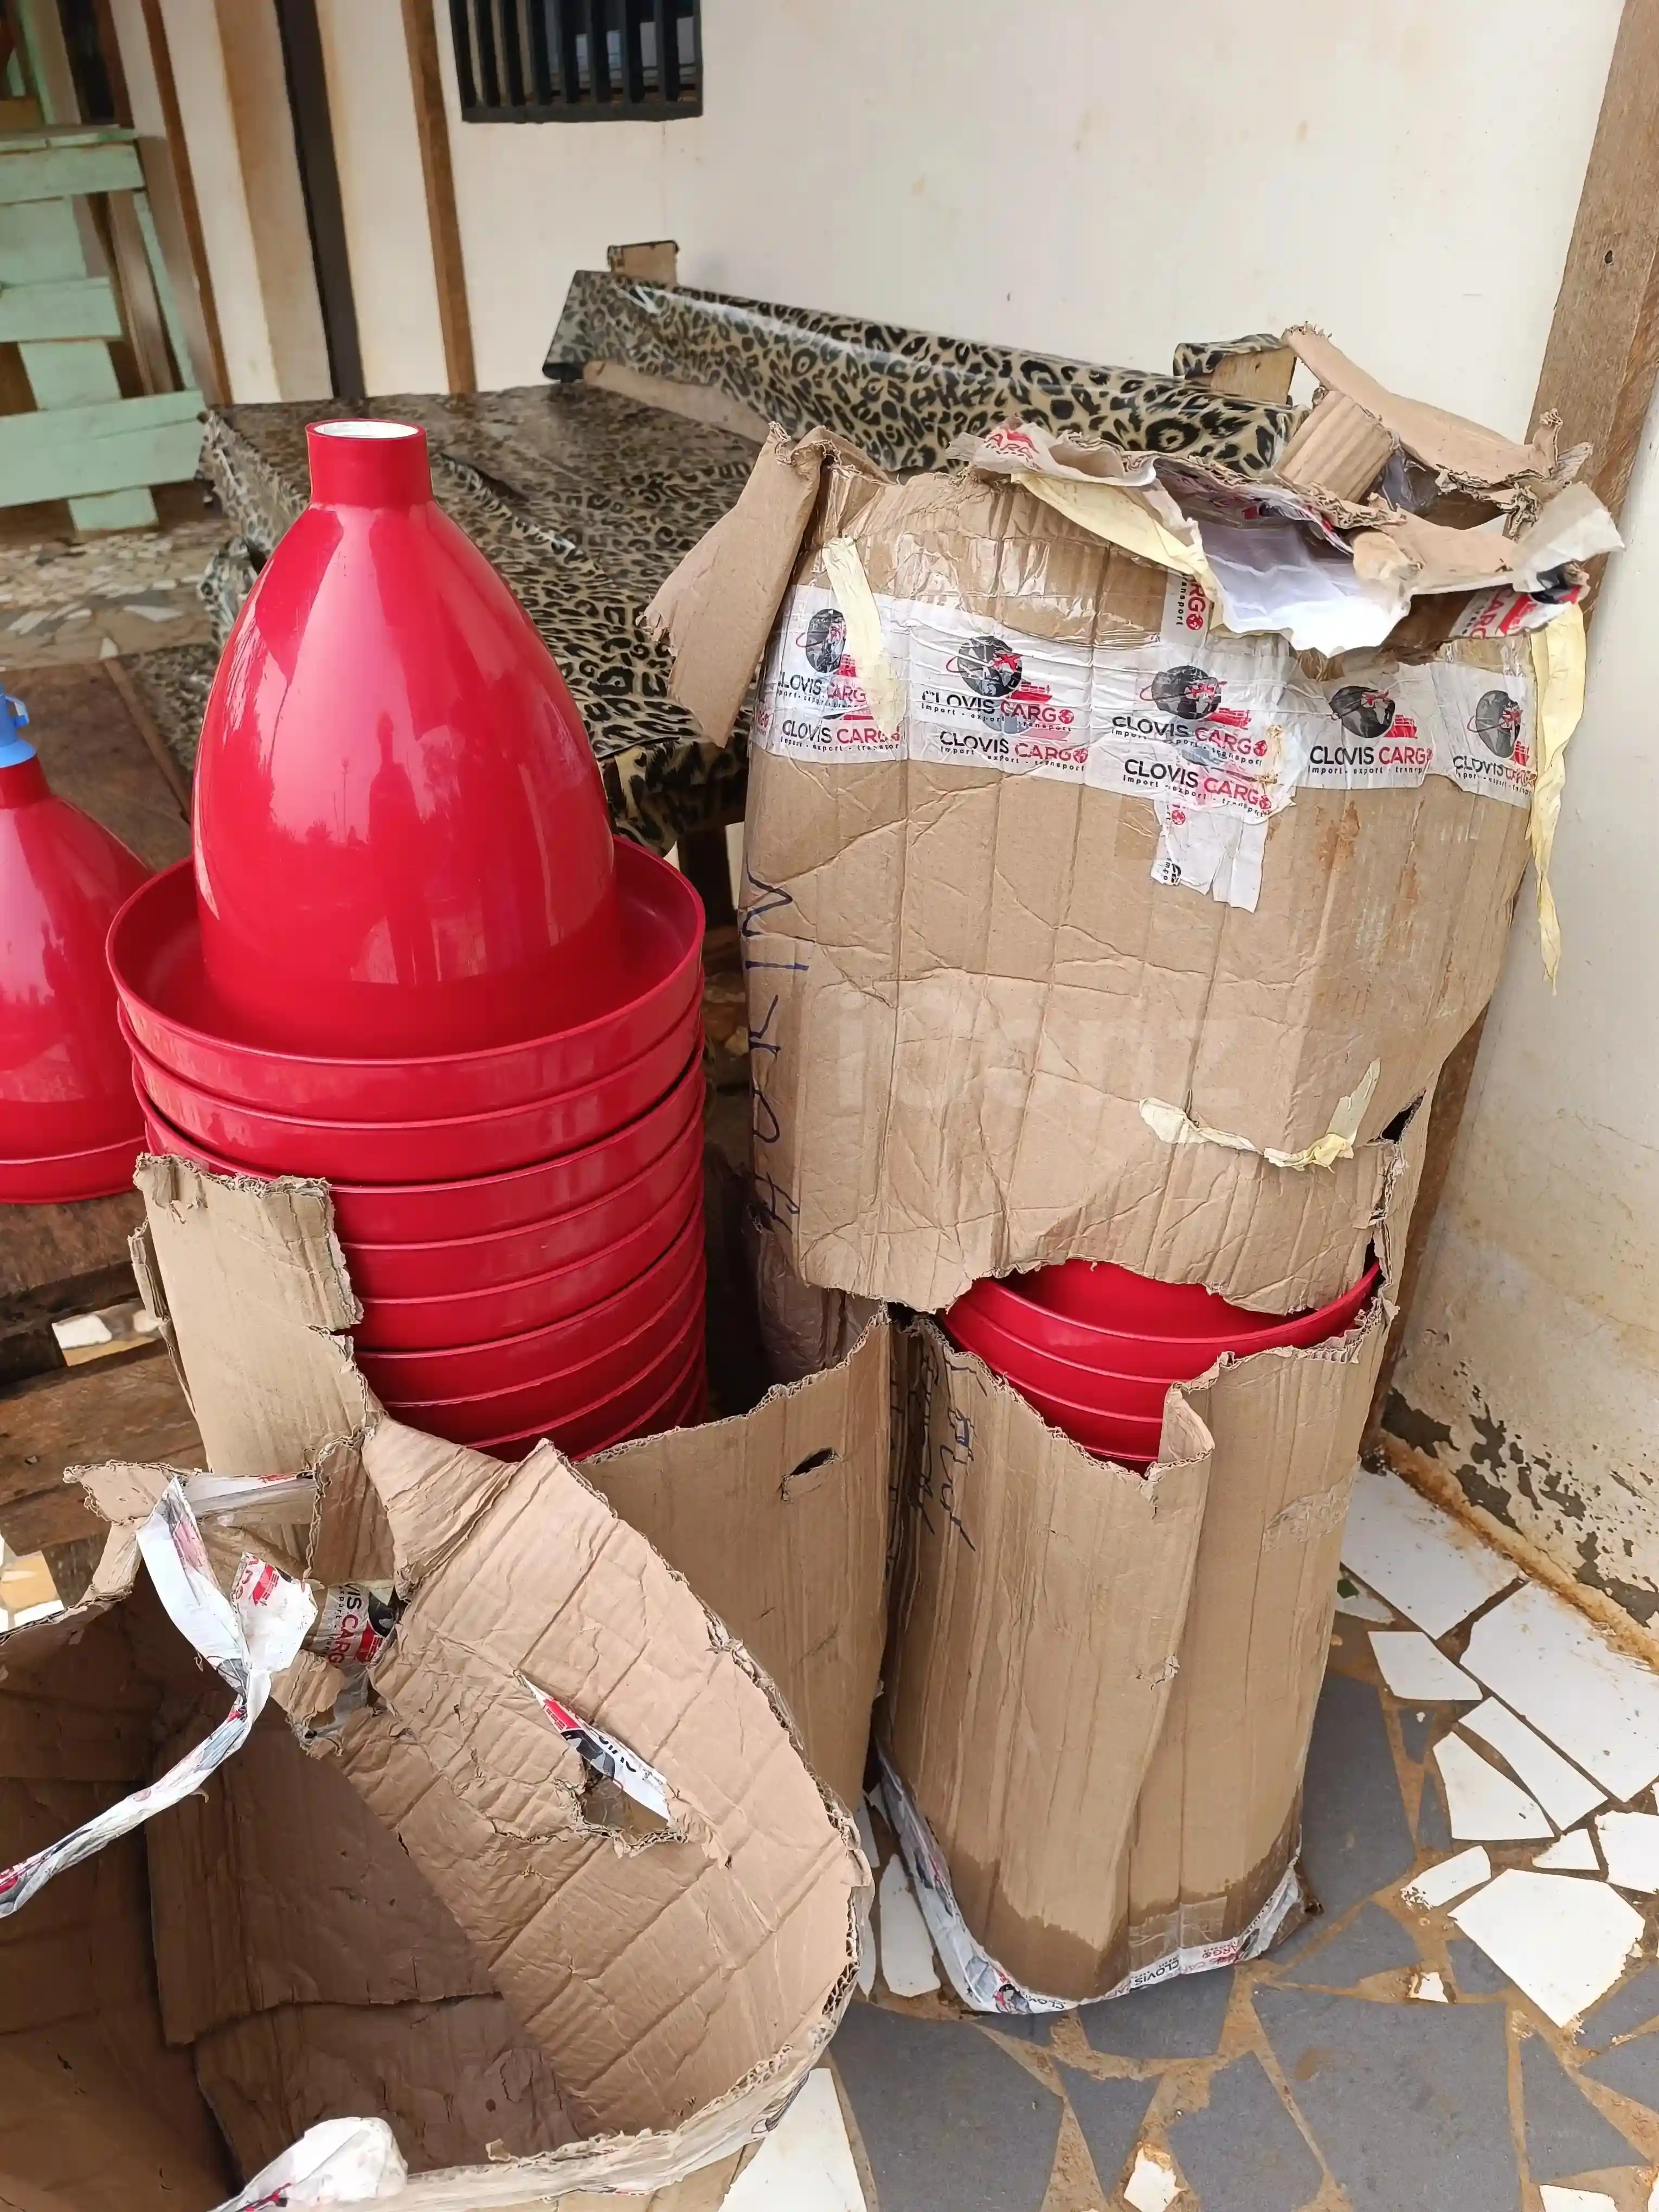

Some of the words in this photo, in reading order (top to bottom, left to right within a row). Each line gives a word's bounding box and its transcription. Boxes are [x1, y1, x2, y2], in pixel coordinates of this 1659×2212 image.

[1186, 579, 1206, 630] RGO
[1470, 586, 1516, 639] CARG
[777, 672, 822, 696] LOVIS
[827, 682, 866, 703] CARG
[782, 719, 833, 744] CLOVIS
[1112, 716, 1189, 737] CLOVIS
[940, 731, 1009, 754] CLOVIS
[1309, 746, 1374, 765] CLOVIS
[1124, 758, 1199, 788] CLOVIS
[328, 1613, 359, 1663] CARG
